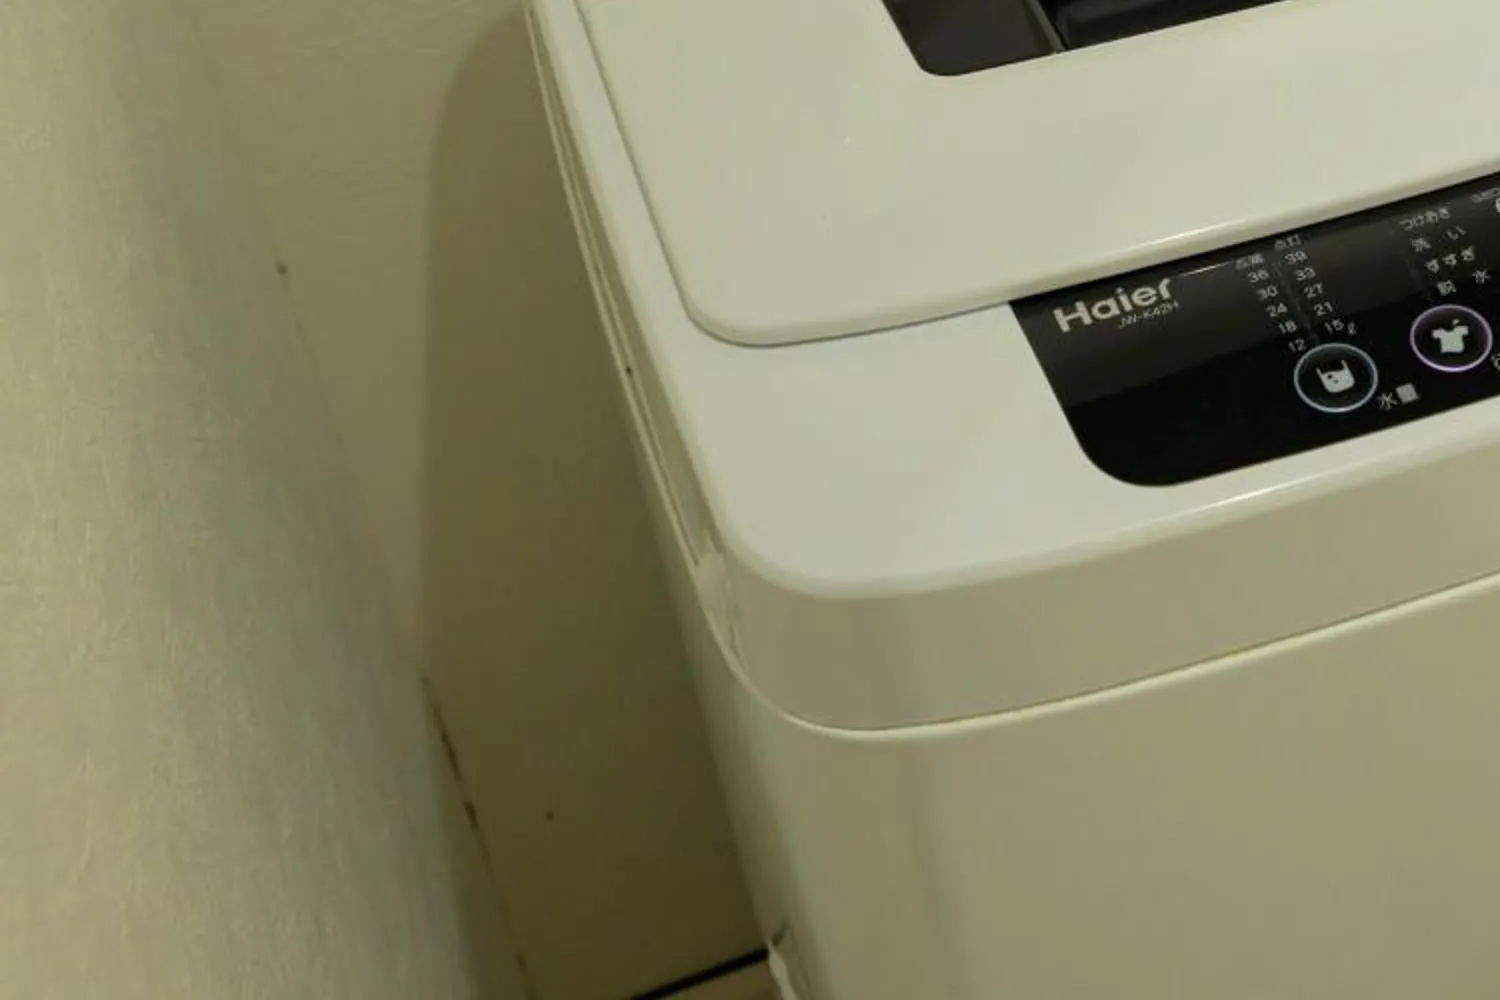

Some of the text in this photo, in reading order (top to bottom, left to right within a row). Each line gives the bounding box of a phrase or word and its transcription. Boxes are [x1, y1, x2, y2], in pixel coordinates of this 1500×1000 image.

[1256, 285, 1278, 300] 30
[1304, 281, 1323, 299] 27
[1053, 277, 1171, 333] Haier
[1265, 302, 1288, 318] 24
[1313, 301, 1333, 317] 21
